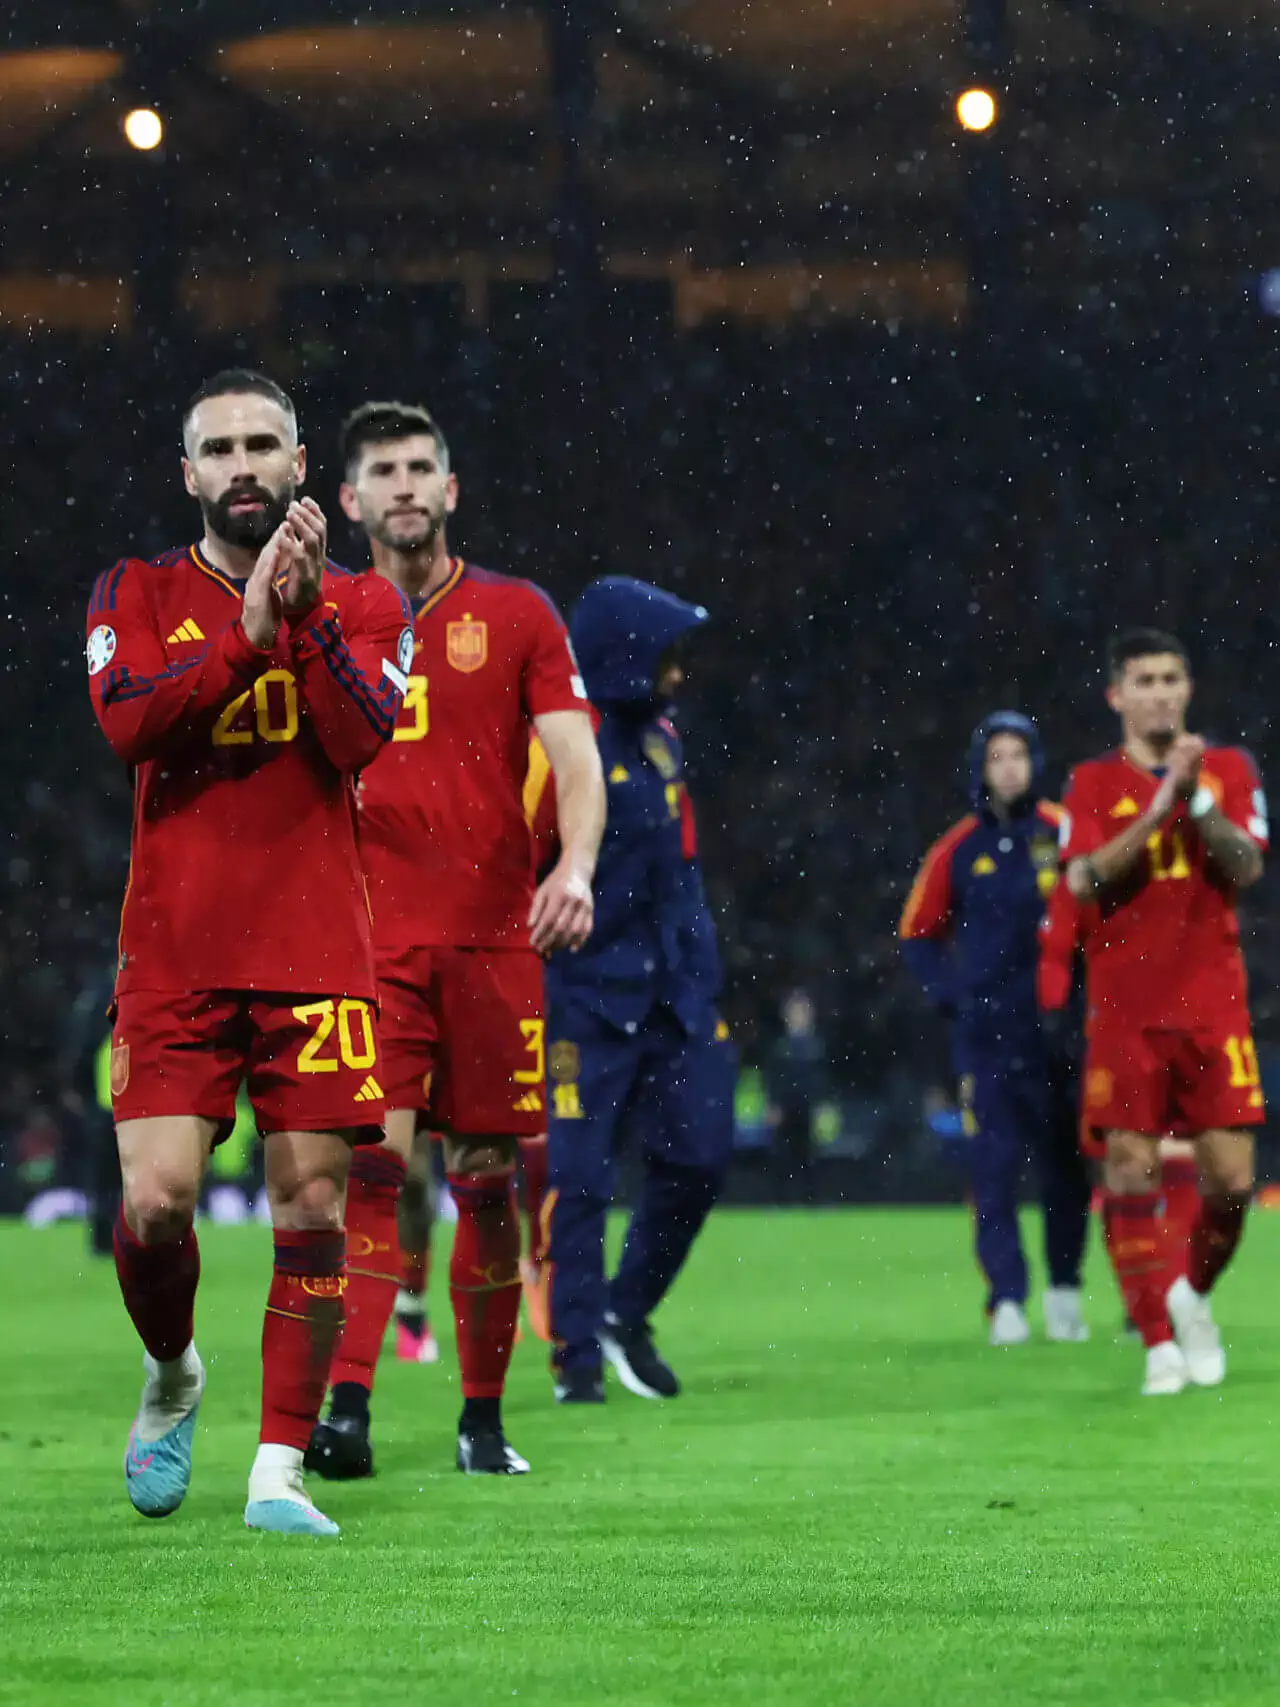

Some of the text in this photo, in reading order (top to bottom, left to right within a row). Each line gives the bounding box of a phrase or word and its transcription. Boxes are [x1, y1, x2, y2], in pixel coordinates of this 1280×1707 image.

[212, 669, 298, 744] 20
[392, 675, 429, 742] 3
[292, 998, 377, 1073] 20
[513, 1018, 545, 1084] 3
[1224, 1035, 1259, 1087] 11
